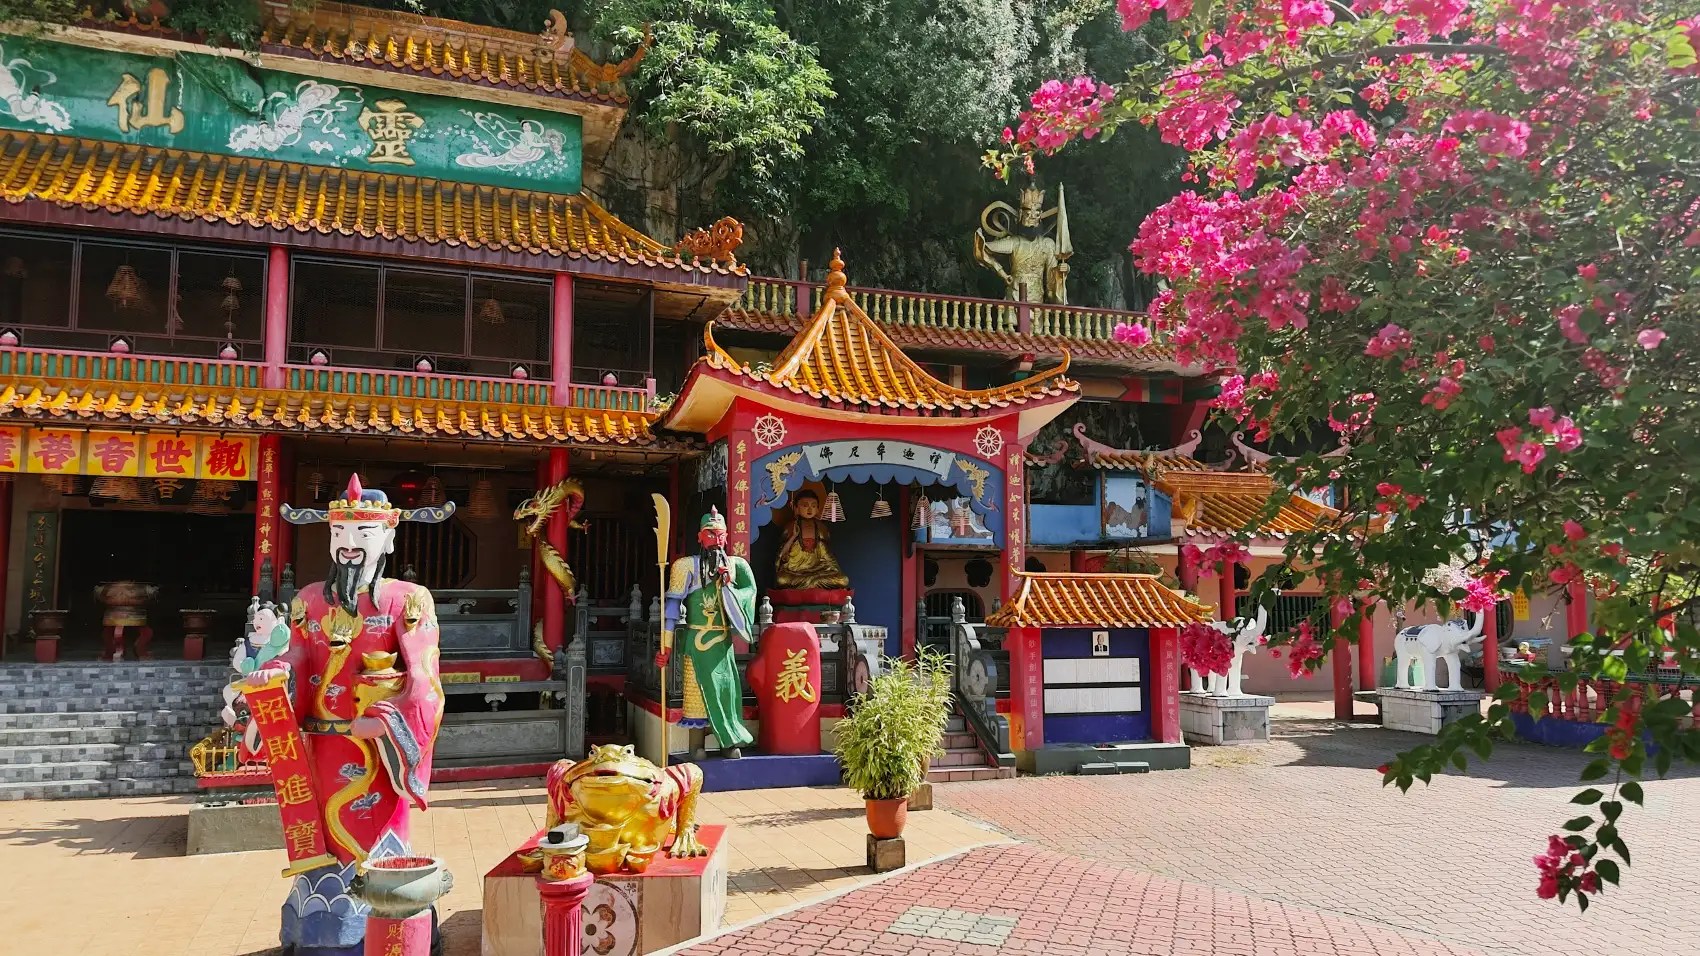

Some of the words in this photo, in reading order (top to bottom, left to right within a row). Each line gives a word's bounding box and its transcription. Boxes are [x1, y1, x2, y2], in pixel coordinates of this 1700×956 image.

[775, 648, 816, 703] 義
[255, 695, 318, 859] 招財進寶
